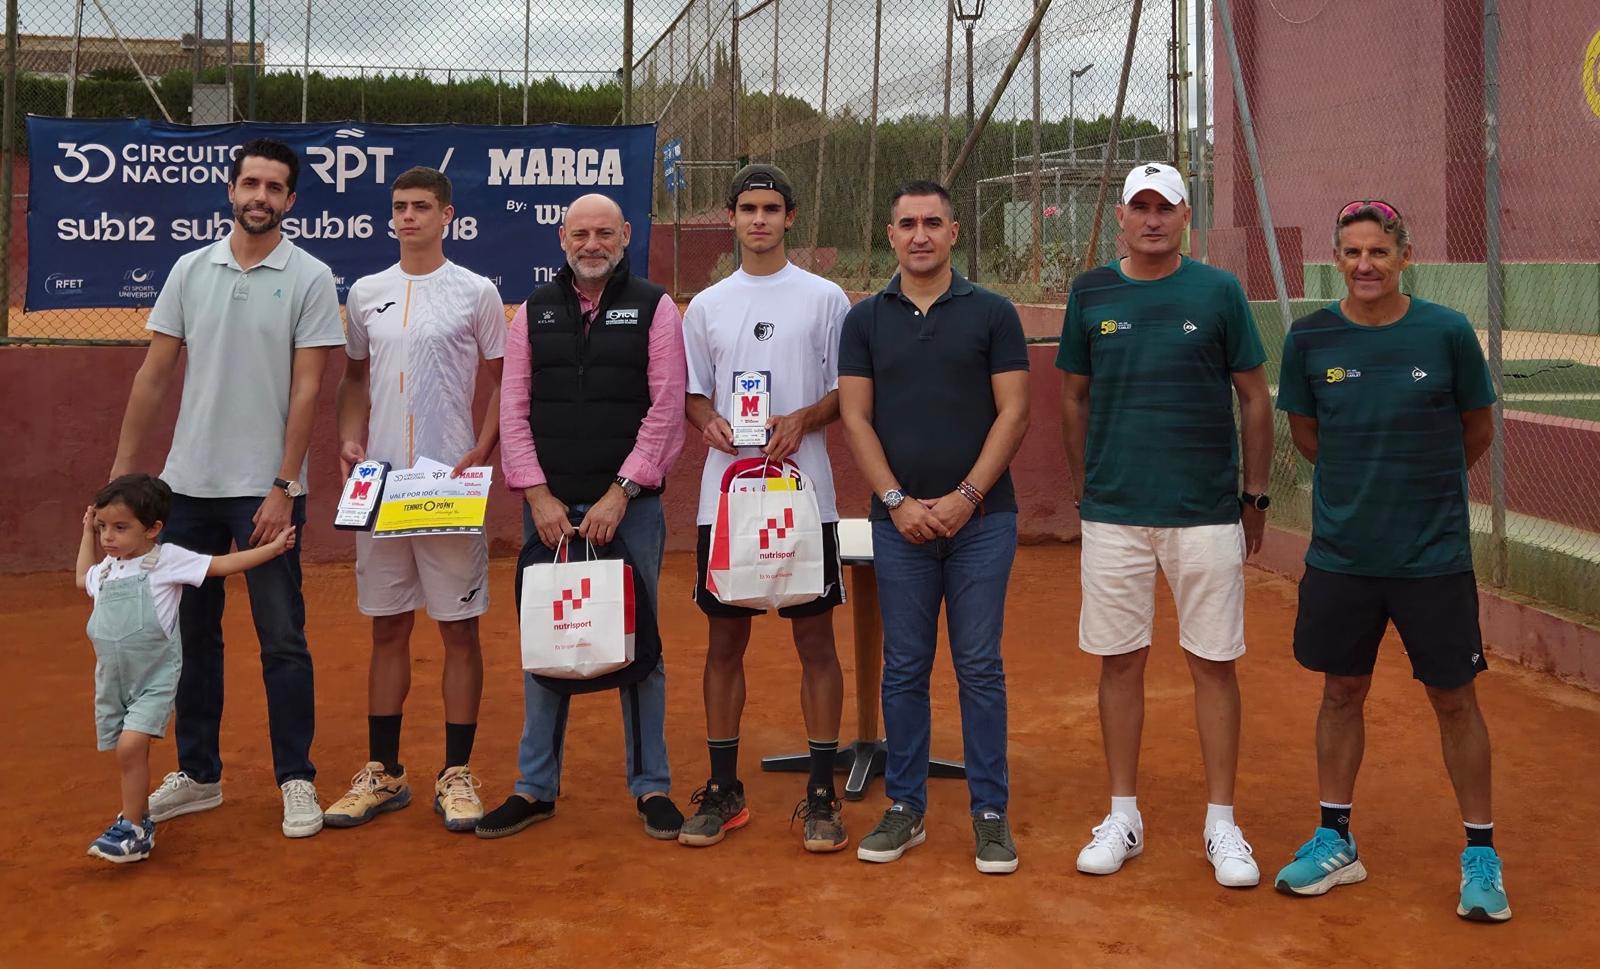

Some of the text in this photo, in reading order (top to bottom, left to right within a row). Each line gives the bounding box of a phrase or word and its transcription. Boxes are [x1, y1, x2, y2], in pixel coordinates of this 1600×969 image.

[53, 143, 116, 183] 30
[488, 148, 624, 185] MARCA
[122, 165, 230, 184] NACION
[506, 199, 527, 212] By:
[57, 212, 156, 241] sub12
[281, 210, 374, 240] sub16
[55, 279, 84, 289] RFET
[741, 396, 760, 417] M
[404, 503, 423, 511] TENNIS
[760, 550, 795, 559] nutrisport
[554, 620, 592, 631] nutrisport
